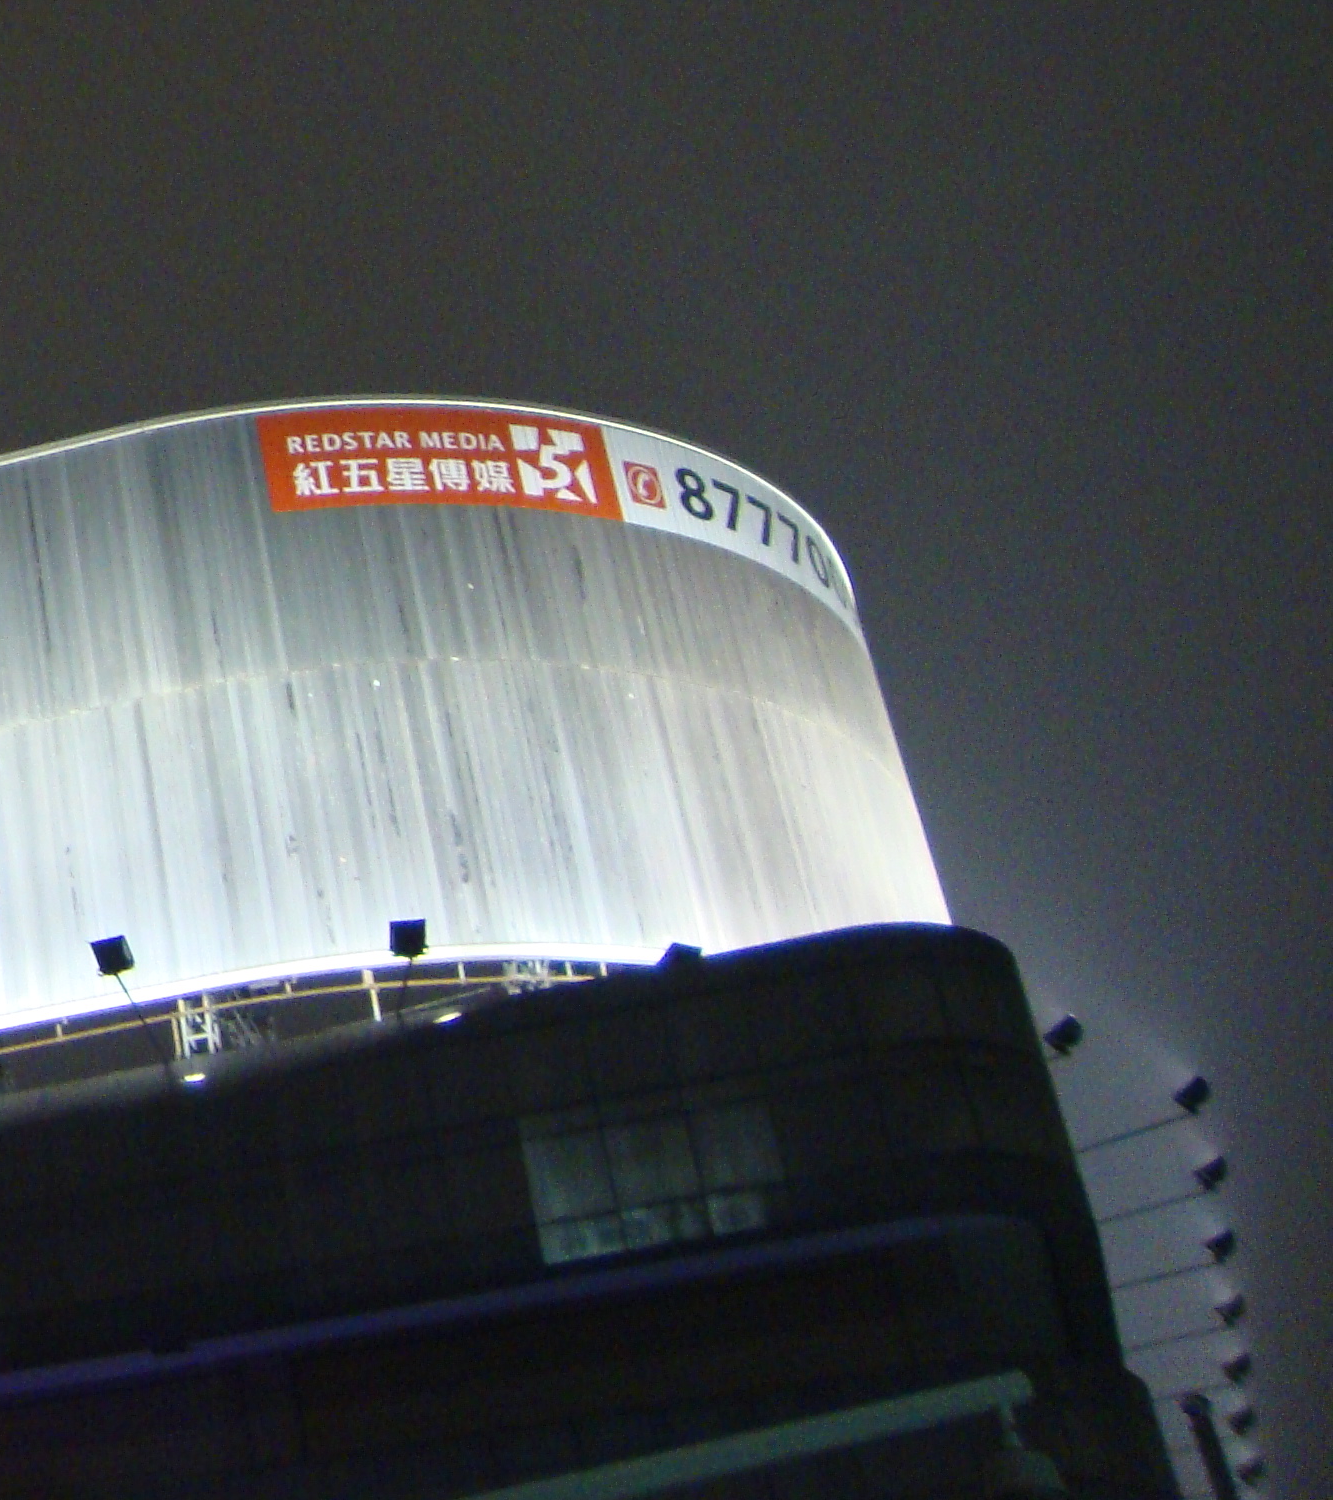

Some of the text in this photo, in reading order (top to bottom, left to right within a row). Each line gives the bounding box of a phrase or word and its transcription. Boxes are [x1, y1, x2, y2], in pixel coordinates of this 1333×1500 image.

[286, 430, 507, 455] REDSTAR MEDIA
[291, 456, 517, 497] 紅五星傳媒
[674, 467, 848, 609] 87770
